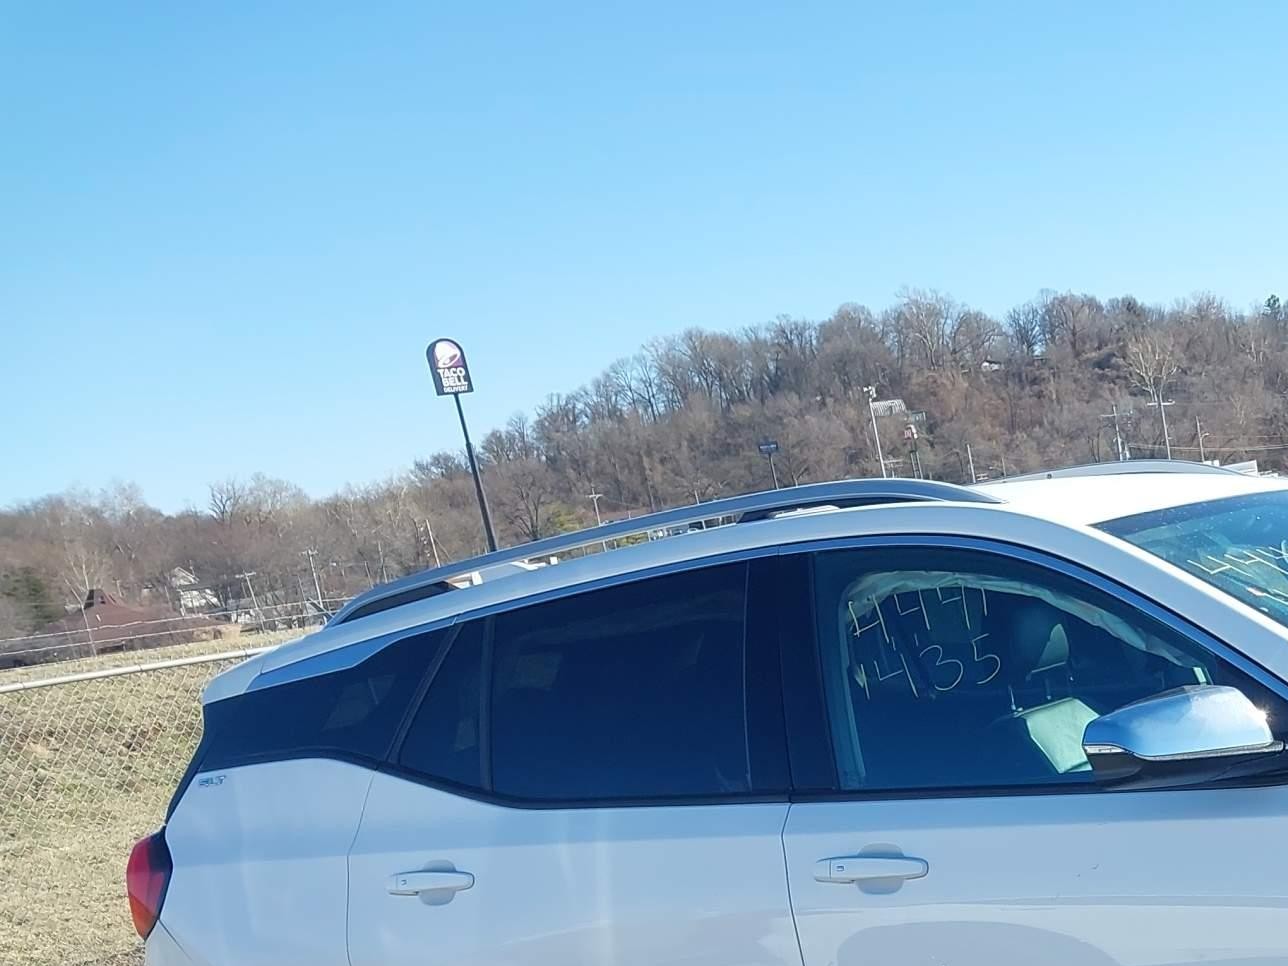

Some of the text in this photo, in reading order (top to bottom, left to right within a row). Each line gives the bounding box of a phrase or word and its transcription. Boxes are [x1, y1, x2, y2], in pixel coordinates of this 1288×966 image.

[437, 367, 466, 378] TACO
[441, 376, 469, 387] BELL
[860, 632, 1000, 700] 1435
